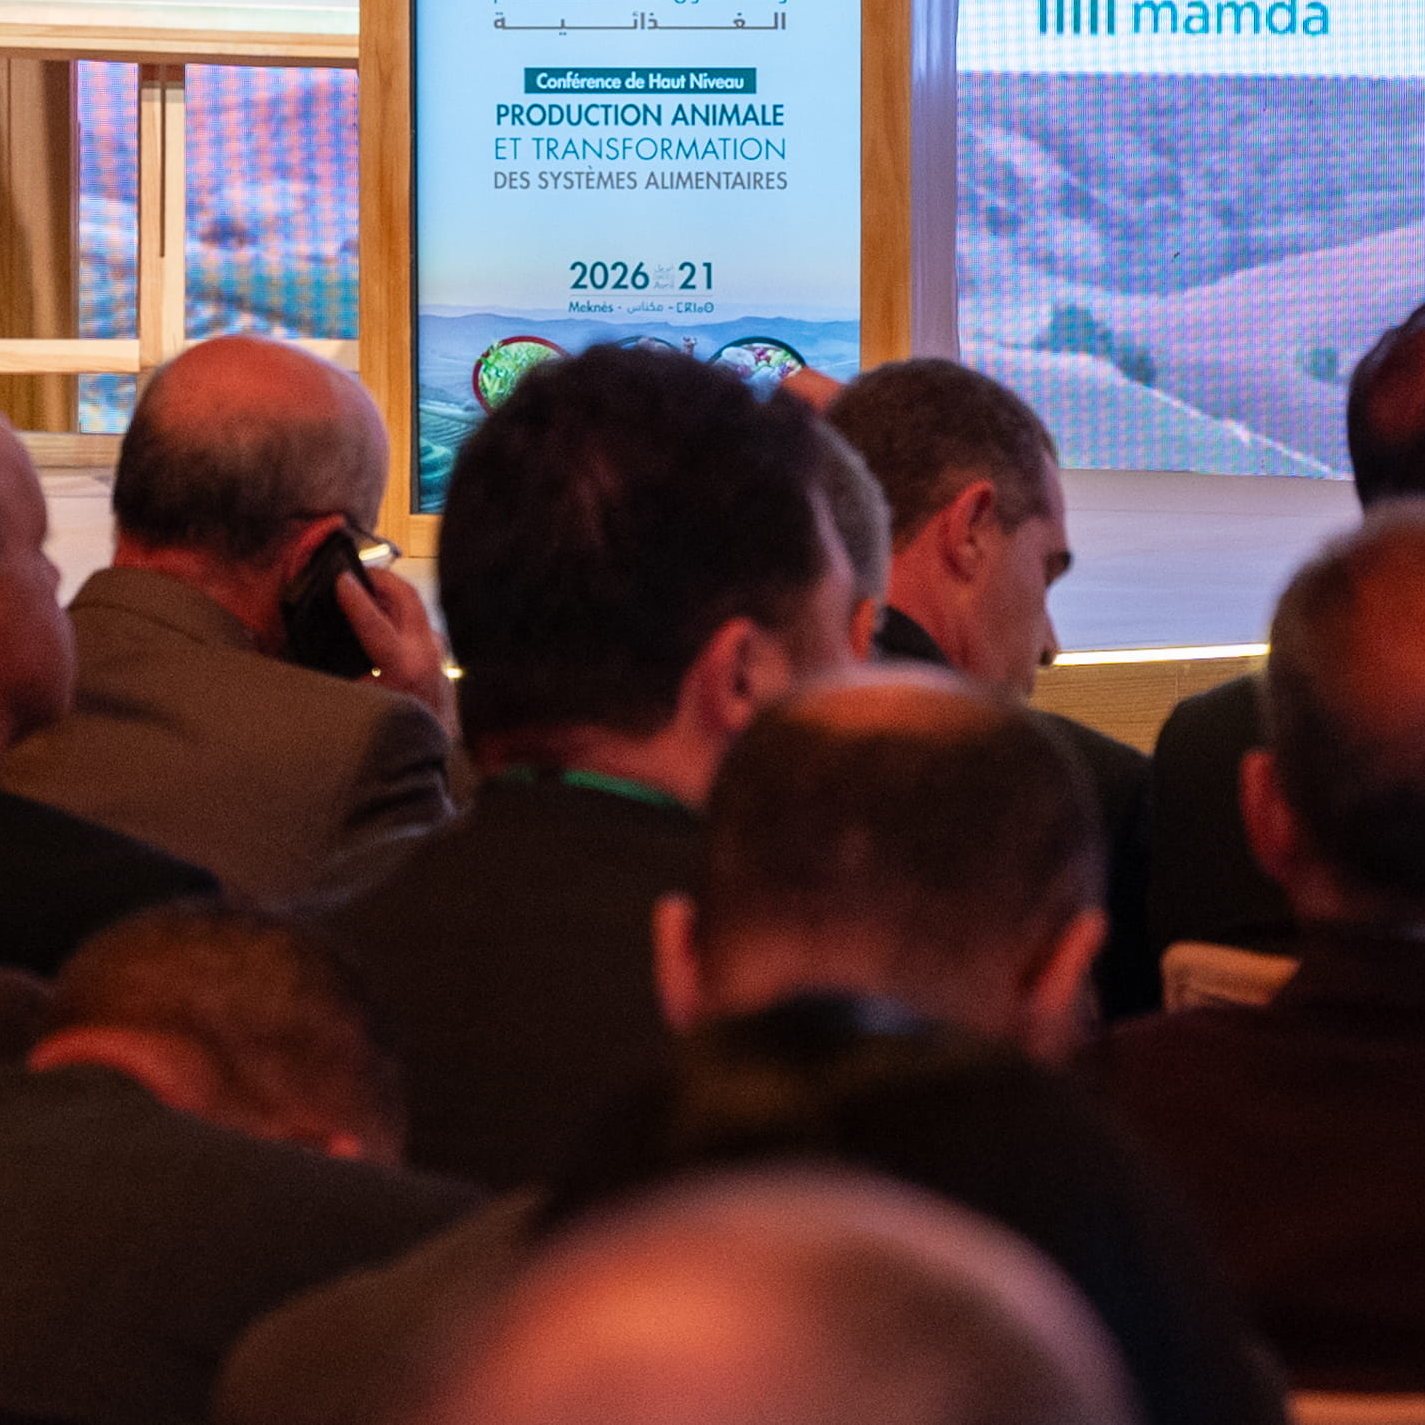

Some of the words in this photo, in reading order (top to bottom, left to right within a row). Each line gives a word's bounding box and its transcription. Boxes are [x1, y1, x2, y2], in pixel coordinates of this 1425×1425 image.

[536, 71, 621, 90] Conférence
[625, 71, 644, 89] de
[648, 73, 686, 89] Haut
[689, 73, 745, 90] Niveau
[496, 103, 663, 126] PRODUCTION
[671, 103, 785, 126] ANIMALE
[495, 137, 522, 160] ET
[532, 137, 786, 160] TRANSFORMATION
[494, 171, 531, 190] DES
[537, 165, 638, 190] SYSTÈMES
[645, 171, 788, 190] ALIMENTAIRES
[570, 261, 650, 290] 2026
[678, 261, 713, 290] 21
[568, 300, 614, 313] Meknès
